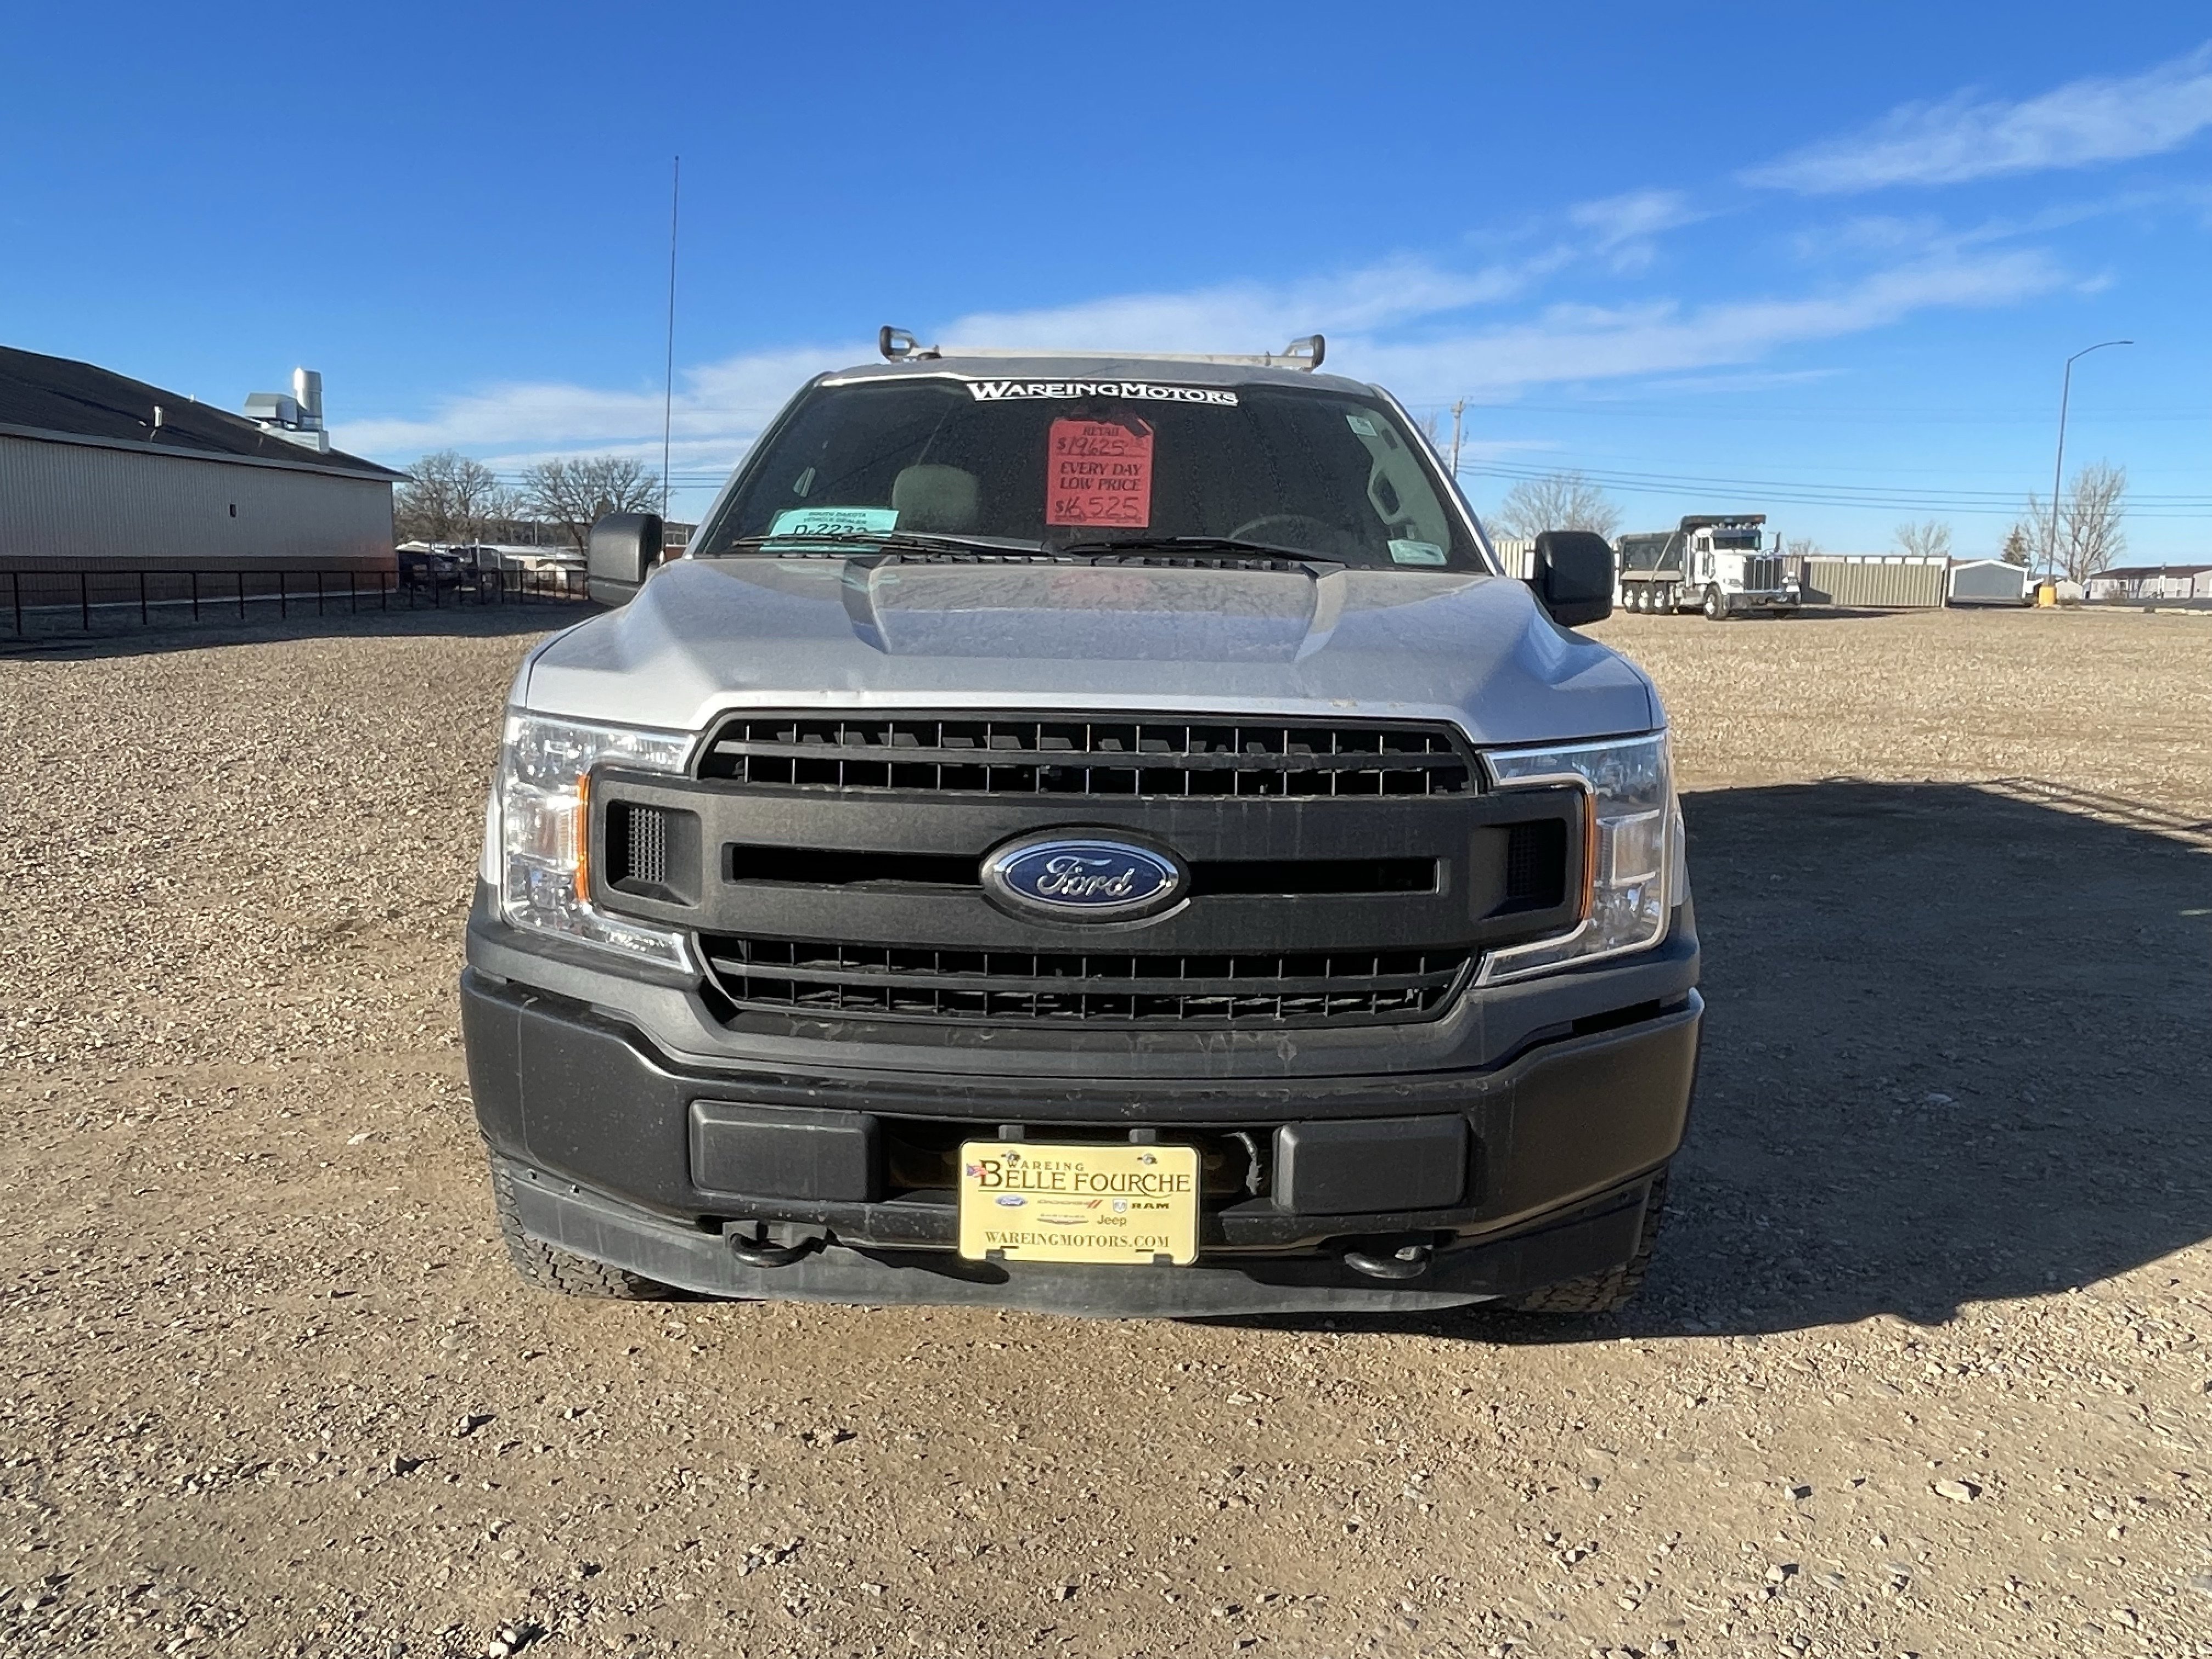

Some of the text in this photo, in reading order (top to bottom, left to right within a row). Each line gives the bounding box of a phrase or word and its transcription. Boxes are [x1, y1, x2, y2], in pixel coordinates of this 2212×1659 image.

[1060, 461, 1142, 476] EVERY DAY
[1060, 477, 1142, 491] LOW PRICE
[1037, 856, 1136, 896] Ford
[1008, 1160, 1084, 1172] WAREING
[979, 1160, 1190, 1198] BELLE FOURCHE
[1097, 1215, 1127, 1227] Jeep
[985, 1231, 1170, 1248] WAREINGMOTORS.COM
